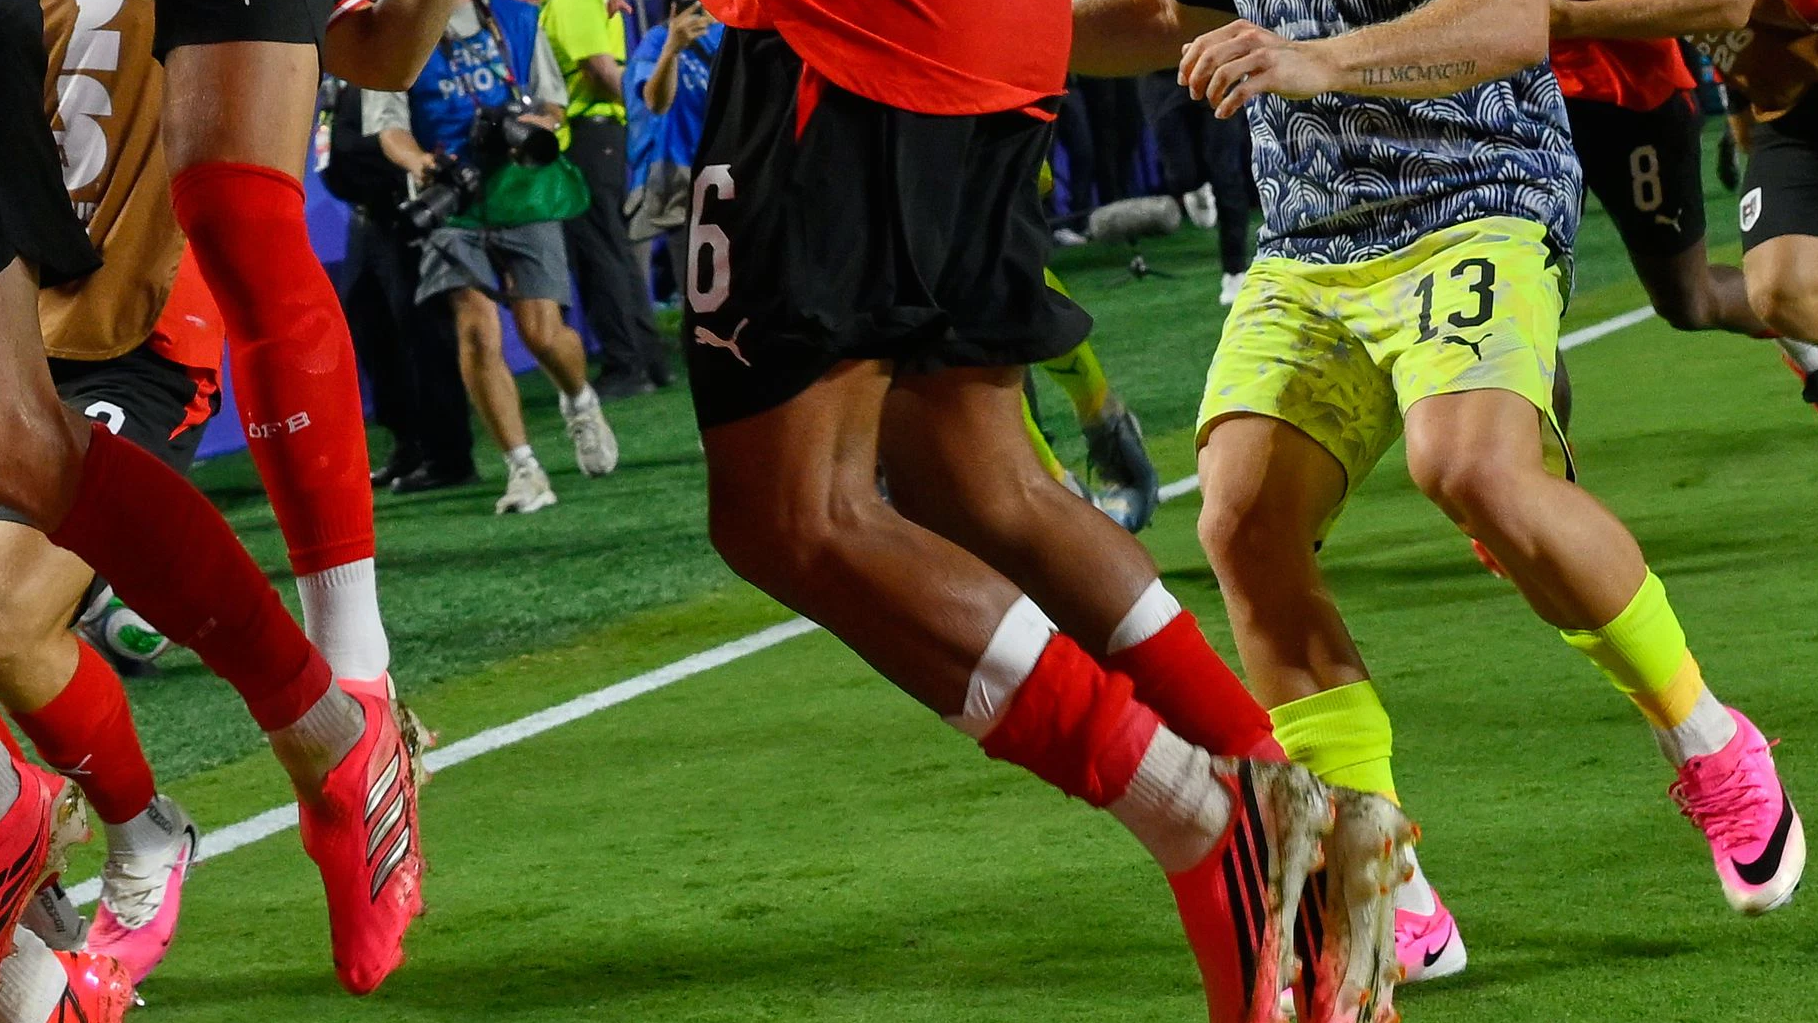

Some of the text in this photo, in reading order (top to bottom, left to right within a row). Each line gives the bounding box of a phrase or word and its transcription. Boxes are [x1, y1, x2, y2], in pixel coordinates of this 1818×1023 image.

[1630, 144, 1663, 213] 8
[686, 163, 736, 313] 6
[1413, 257, 1496, 345] 13
